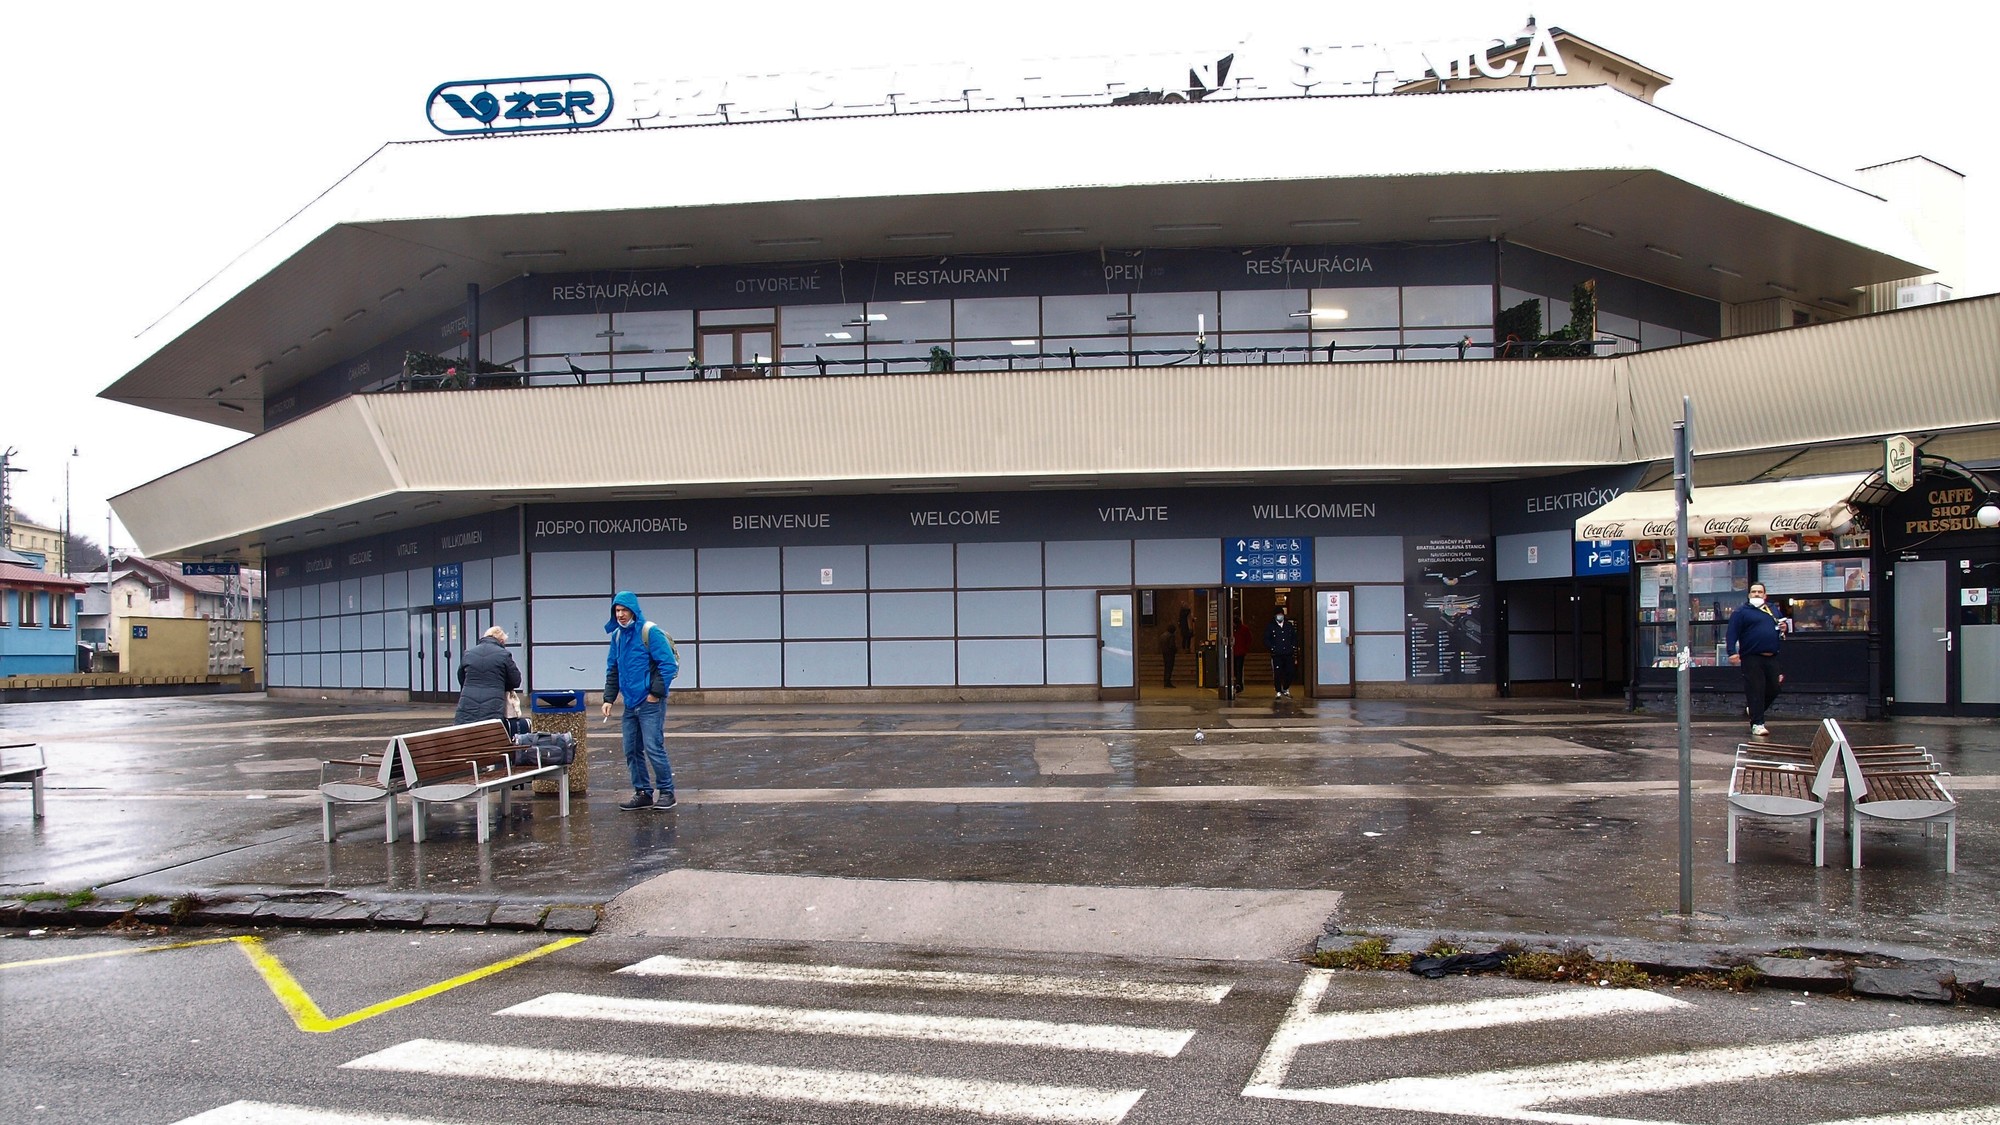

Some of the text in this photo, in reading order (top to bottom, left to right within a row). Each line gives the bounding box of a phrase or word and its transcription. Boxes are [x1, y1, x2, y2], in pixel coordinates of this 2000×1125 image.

[1104, 264, 1144, 280] OPEN
[1246, 255, 1373, 276] REŠTAURÁCIA
[736, 269, 821, 293] OTVORENÉ
[894, 266, 1010, 287] RESTAURANT
[552, 281, 669, 301] REŠTAURÁCIA
[1527, 487, 1619, 513] ELEKTRIČKY
[1928, 488, 1974, 505] CAFFE
[910, 510, 1001, 526] WELCOME
[1098, 506, 1169, 522] VITAJTE
[1253, 503, 1376, 519] WILLKOMMEN
[1931, 505, 1971, 518] SHOP
[535, 517, 688, 537] ДОБРО ПОЖАЛОВАТЬ
[732, 513, 831, 530] BIENVENUE
[1583, 522, 1625, 538] Coca-Cola
[1643, 520, 1677, 537] Coca-Co
[1704, 517, 1752, 535] Coca-Cola
[1770, 512, 1821, 532] Coca-Cola
[1906, 516, 2000, 534] PRESBUR
[441, 530, 483, 550] WILLKOMMEN
[397, 541, 418, 557] VITAJTE
